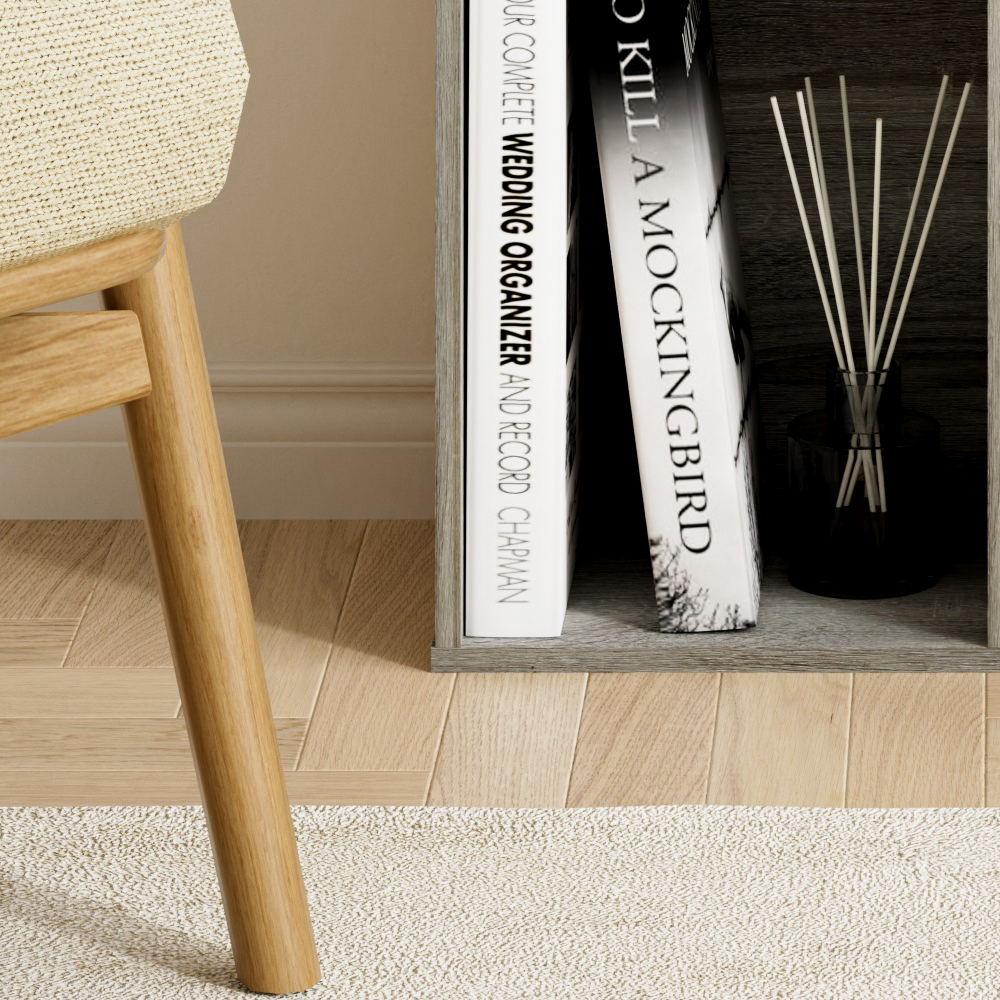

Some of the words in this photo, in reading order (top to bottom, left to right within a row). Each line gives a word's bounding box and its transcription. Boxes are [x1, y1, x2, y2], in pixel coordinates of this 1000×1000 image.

[502, 32, 535, 126] COMPLETE
[616, 38, 661, 143] KILL
[500, 132, 534, 234] WEDDING
[631, 155, 665, 184] A
[499, 242, 534, 366] ORGANIZER
[499, 373, 532, 415] AND
[639, 198, 712, 554] MOCKINGBIRD
[497, 422, 531, 494] RECORD
[497, 507, 530, 603] CHAPMAN
